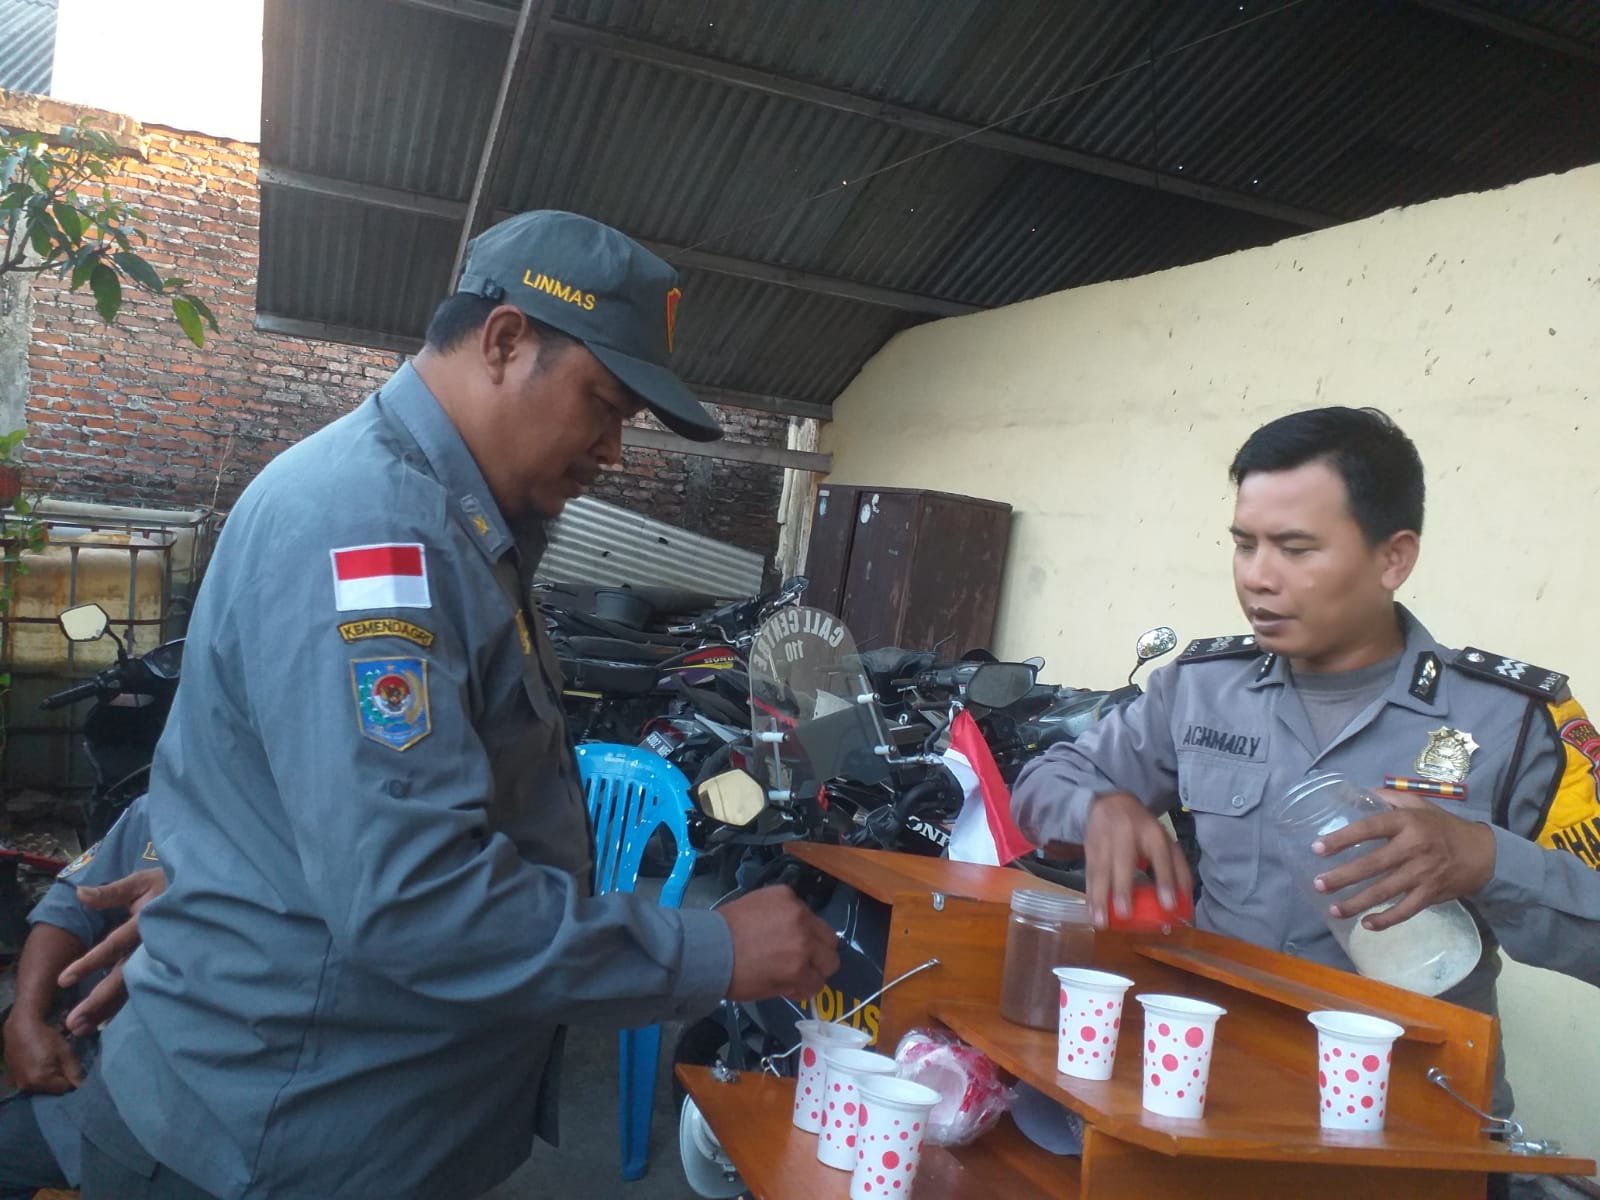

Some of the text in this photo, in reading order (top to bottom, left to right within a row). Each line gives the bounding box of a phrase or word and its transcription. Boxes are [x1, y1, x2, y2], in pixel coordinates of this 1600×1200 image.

[522, 269, 596, 310] LINMAS
[342, 620, 432, 643] KEMENDAGRI
[801, 984, 881, 1046] OLIS
